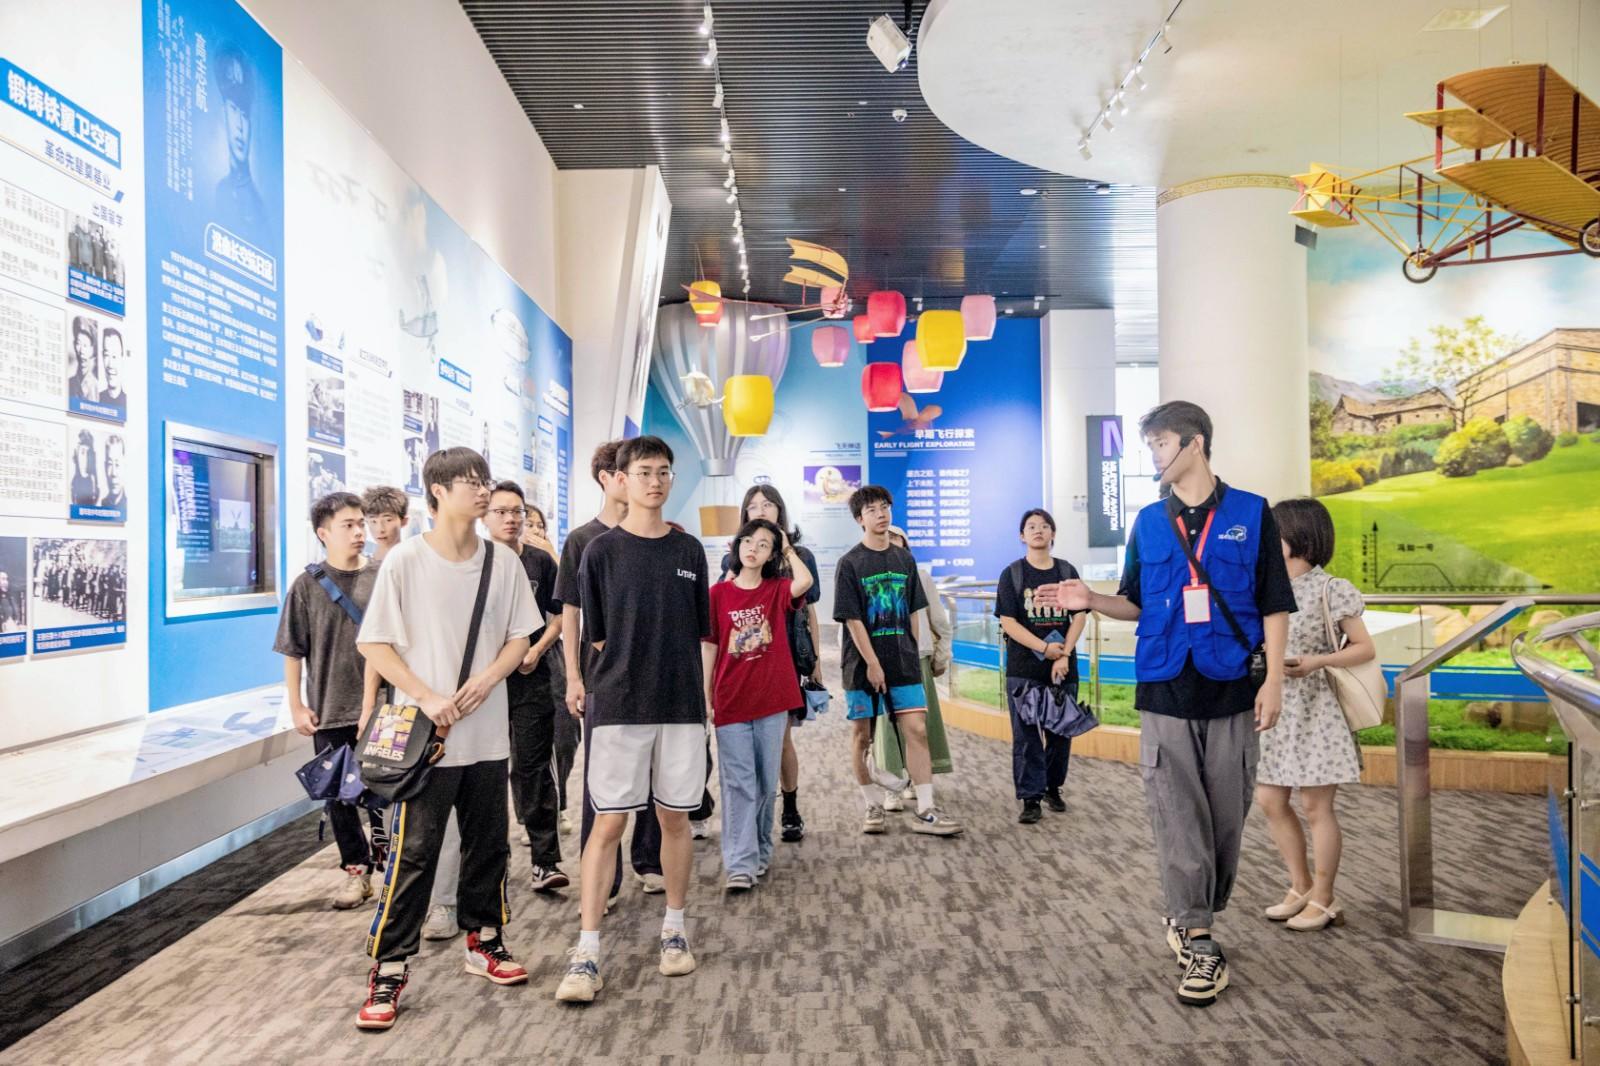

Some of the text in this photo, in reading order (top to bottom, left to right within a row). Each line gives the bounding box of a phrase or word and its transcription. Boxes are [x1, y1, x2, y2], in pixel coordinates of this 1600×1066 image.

[914, 428, 976, 440] 早期飞行探索
[874, 441, 897, 449] EARLY
[925, 440, 976, 448] EXPLORATION
[363, 741, 405, 761] ANGELES
